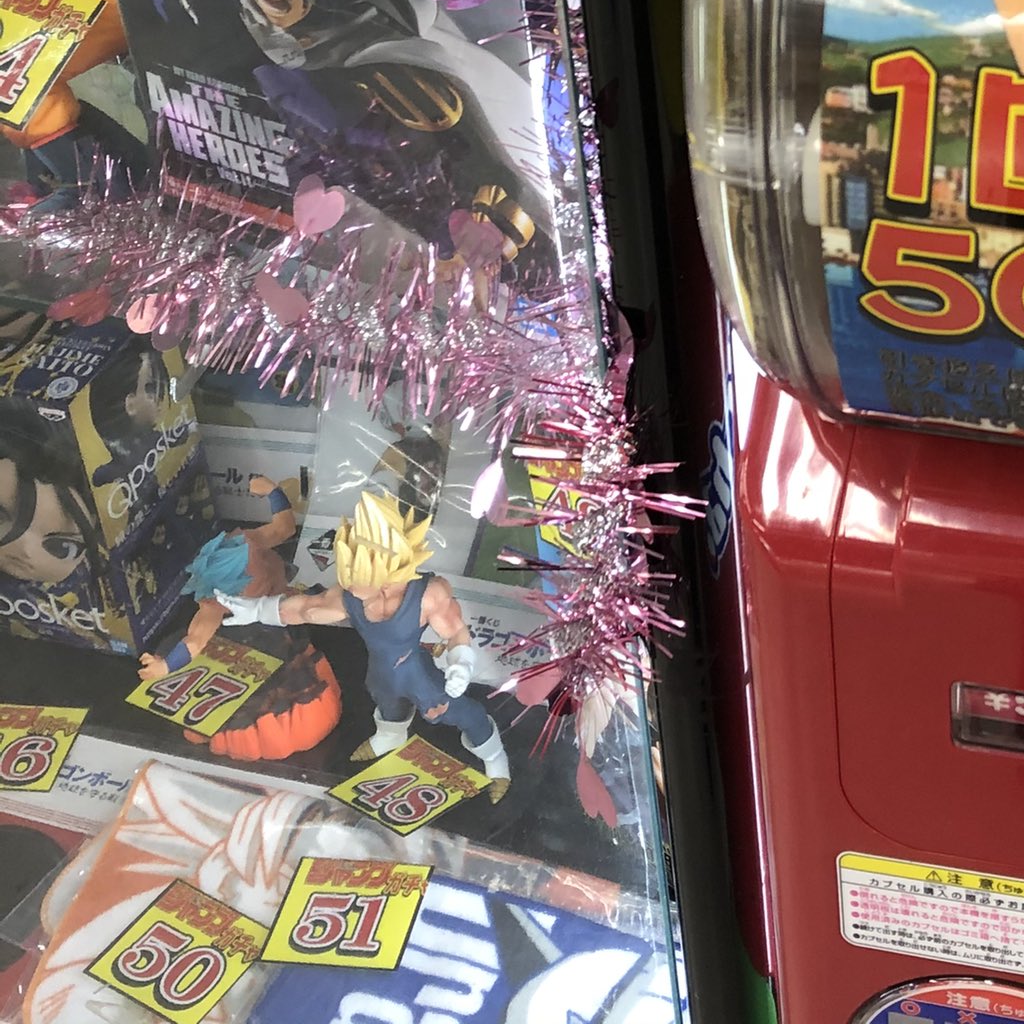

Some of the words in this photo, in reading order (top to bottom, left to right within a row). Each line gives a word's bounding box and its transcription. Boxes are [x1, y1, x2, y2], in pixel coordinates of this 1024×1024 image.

[146, 71, 298, 158] AMAZING
[145, 666, 248, 725] 47
[351, 772, 449, 826] 48
[288, 892, 389, 957] 51
[111, 921, 226, 1011] 50
